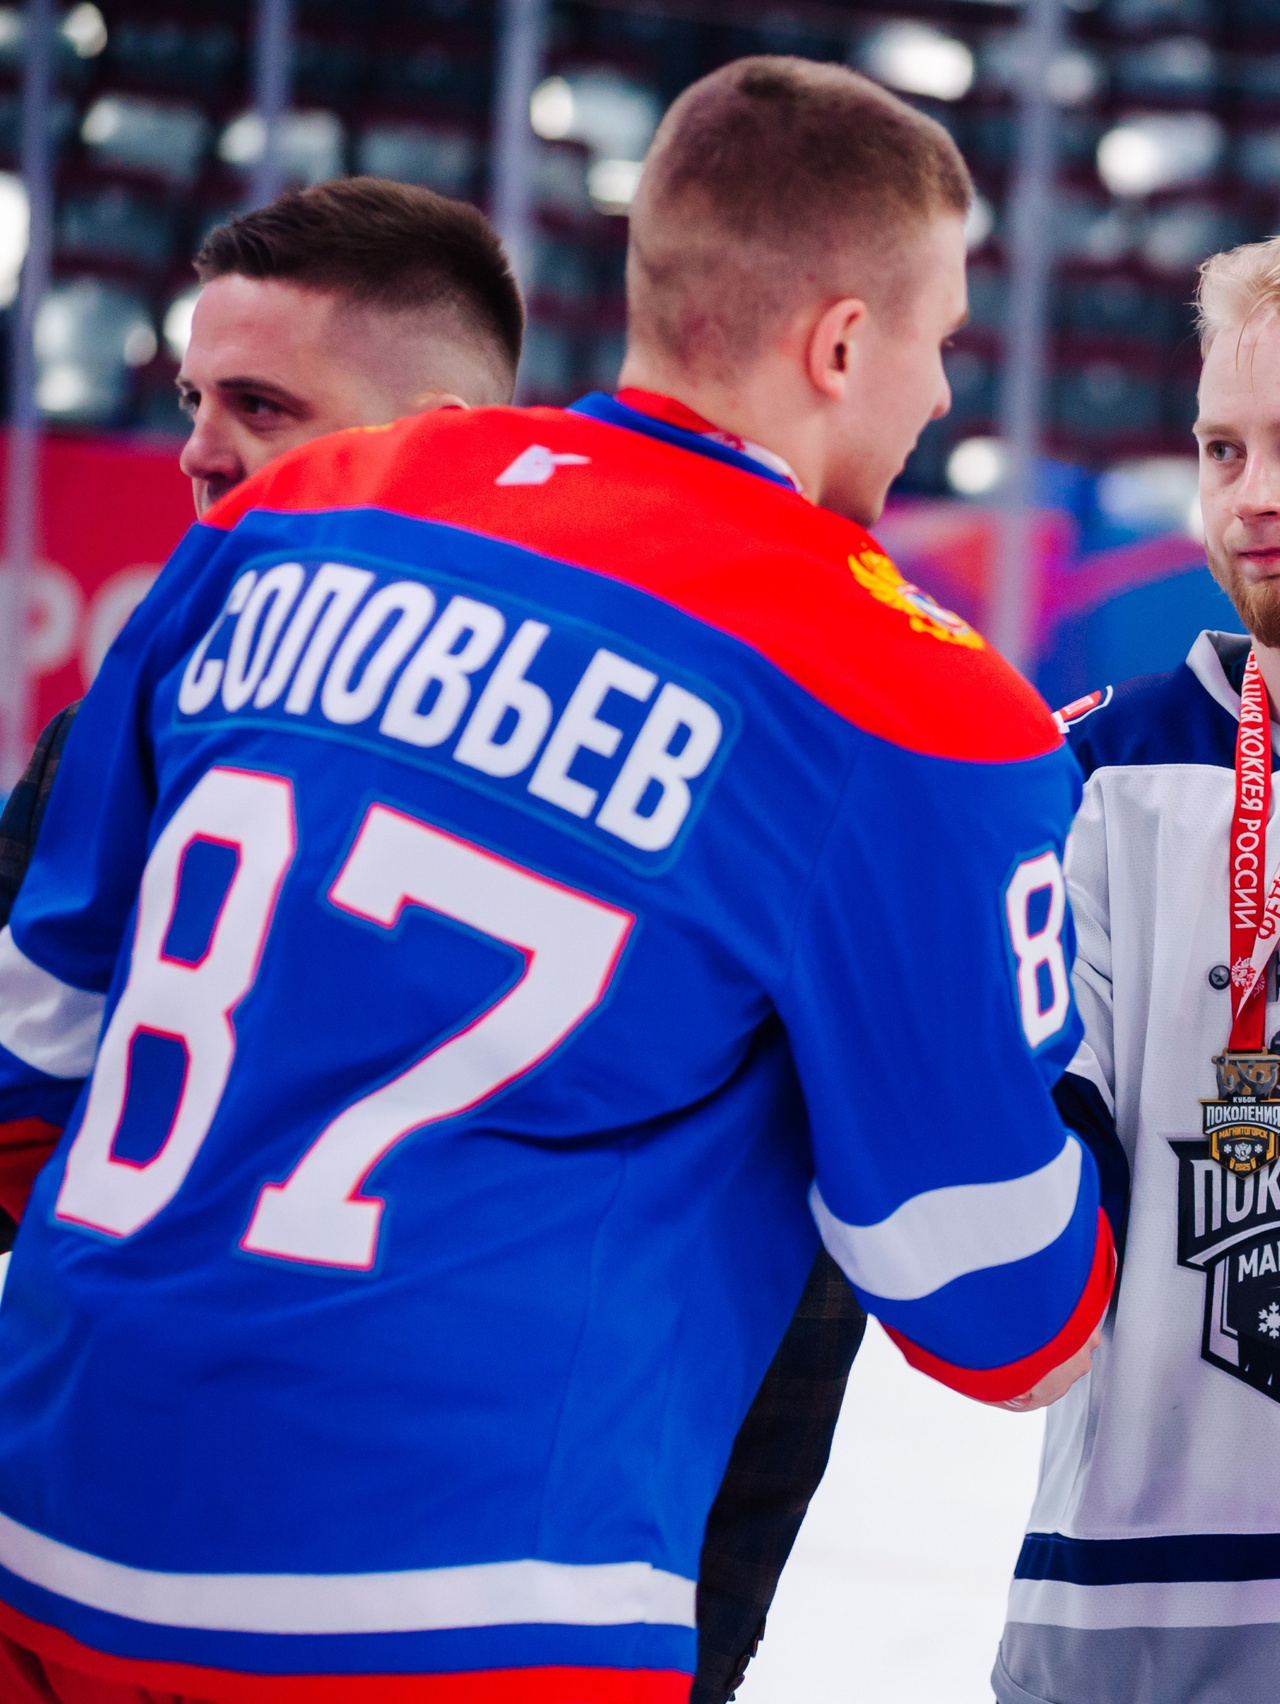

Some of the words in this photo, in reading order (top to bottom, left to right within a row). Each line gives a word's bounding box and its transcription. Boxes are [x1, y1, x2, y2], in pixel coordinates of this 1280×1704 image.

[177, 563, 722, 852] СОЛОВЬЕВ
[1240, 727, 1266, 812] ХОККЕЯ
[1234, 818, 1262, 930] РОССИИ
[53, 766, 636, 1270] 87
[1219, 1126, 1268, 1139] МАГНИТОГОРСК
